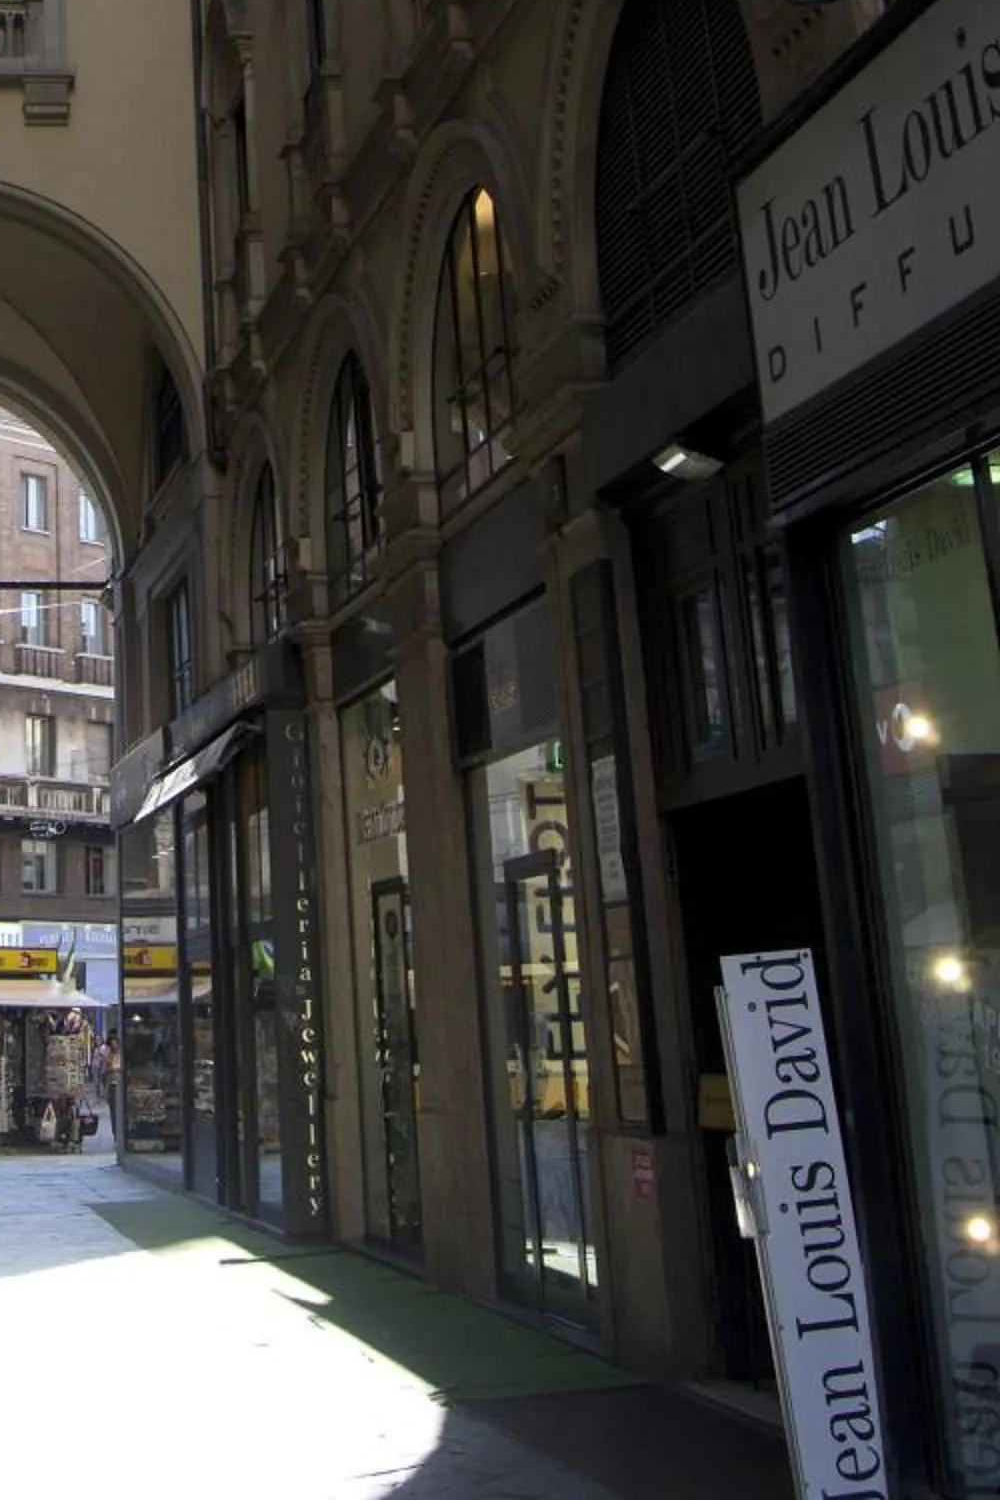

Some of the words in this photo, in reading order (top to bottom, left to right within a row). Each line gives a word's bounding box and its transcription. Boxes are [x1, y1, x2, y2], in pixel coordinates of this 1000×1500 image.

[759, 174, 855, 301] Jean
[859, 25, 1000, 219] Louis
[301, 998, 324, 1218] Jewellery
[739, 951, 829, 1141] David
[779, 1160, 860, 1341] Louis
